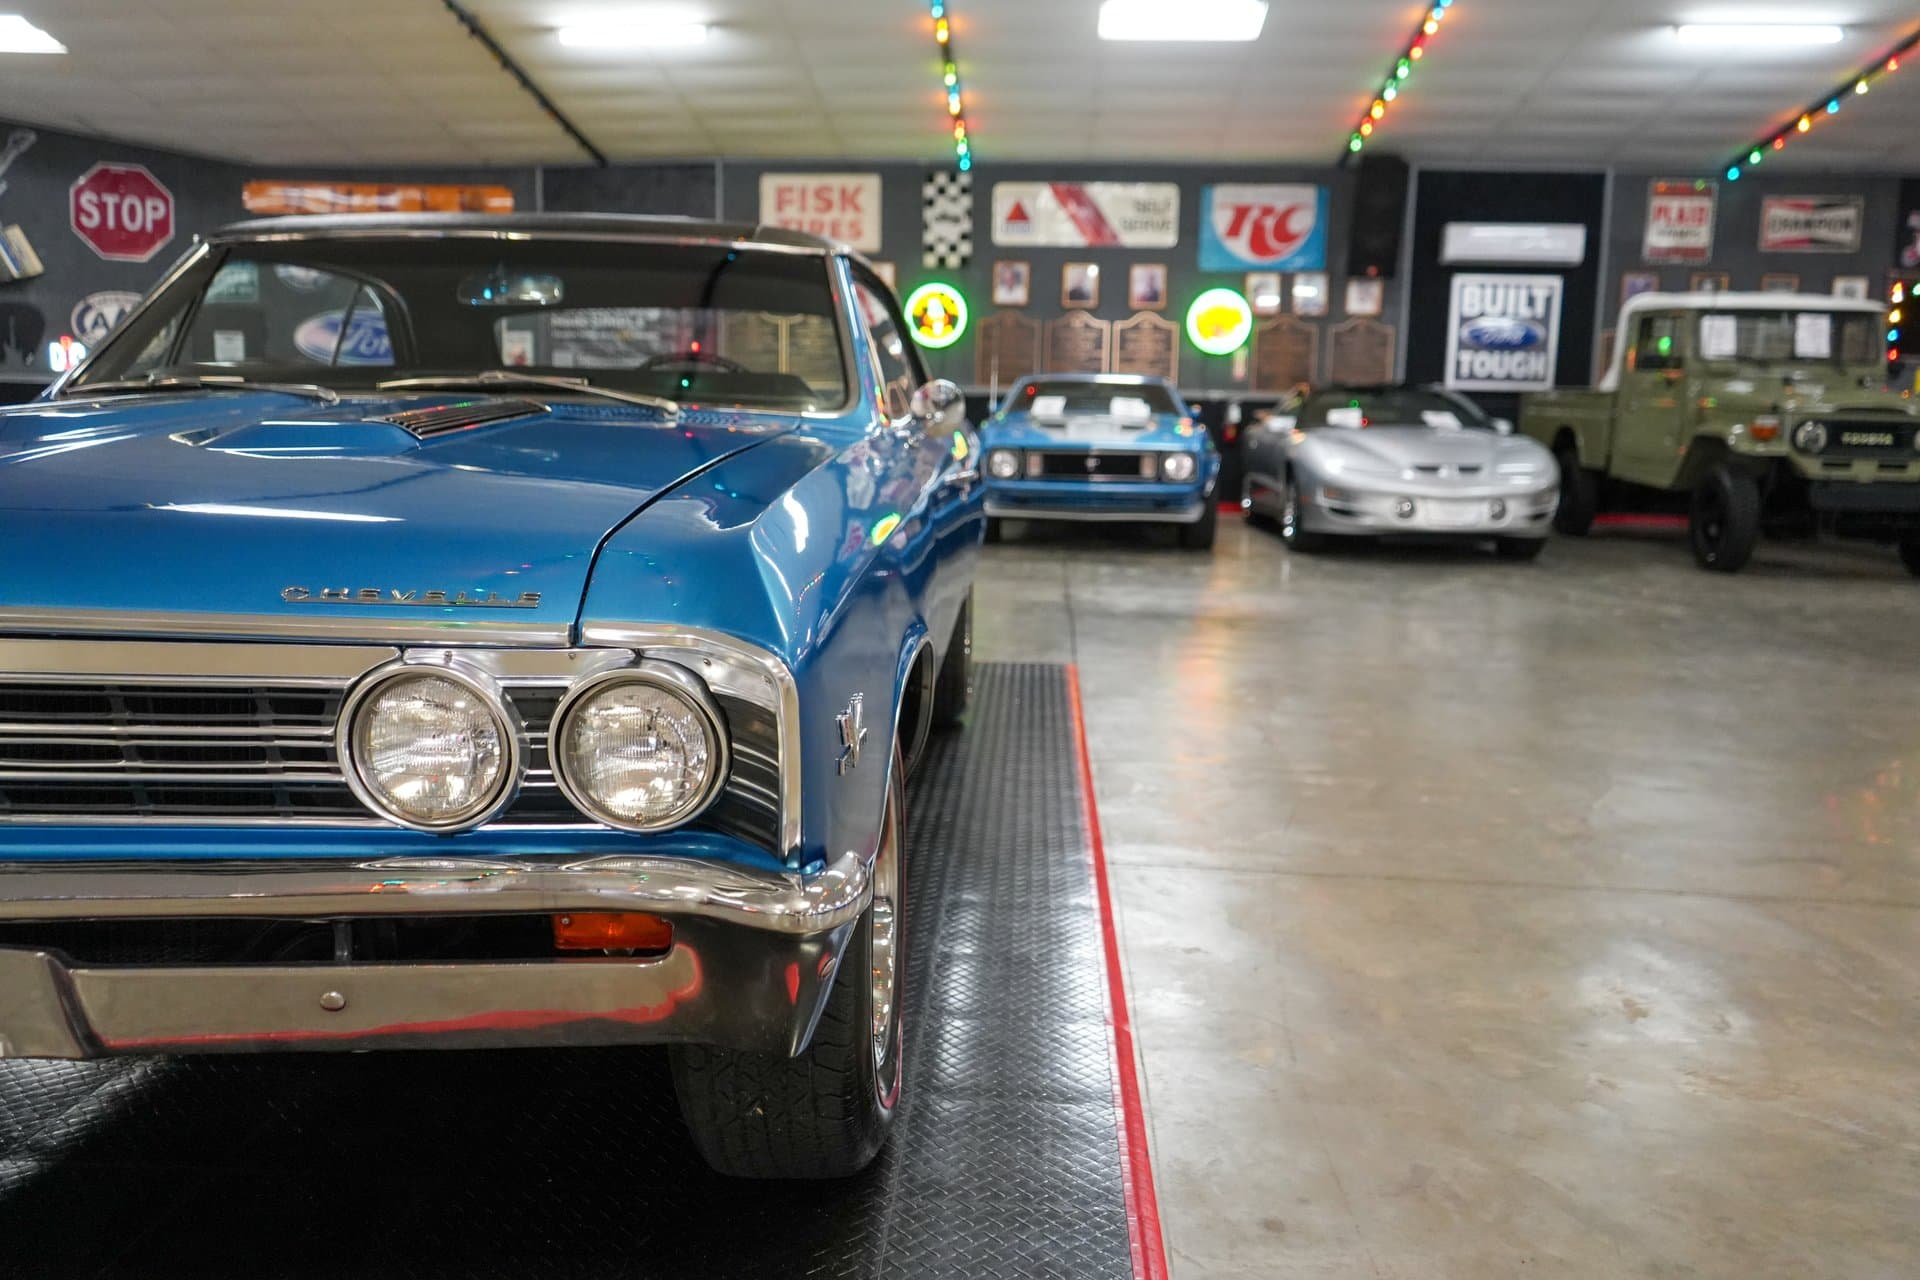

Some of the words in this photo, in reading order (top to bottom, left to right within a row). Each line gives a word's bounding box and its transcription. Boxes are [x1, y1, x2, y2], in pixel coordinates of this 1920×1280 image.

[79, 190, 167, 233] STOP
[775, 184, 864, 213] FISK
[1219, 202, 1310, 258] RC
[1461, 283, 1553, 318] BUILT
[1457, 350, 1546, 379] TOUGH
[279, 586, 543, 608] CHEVELLE
